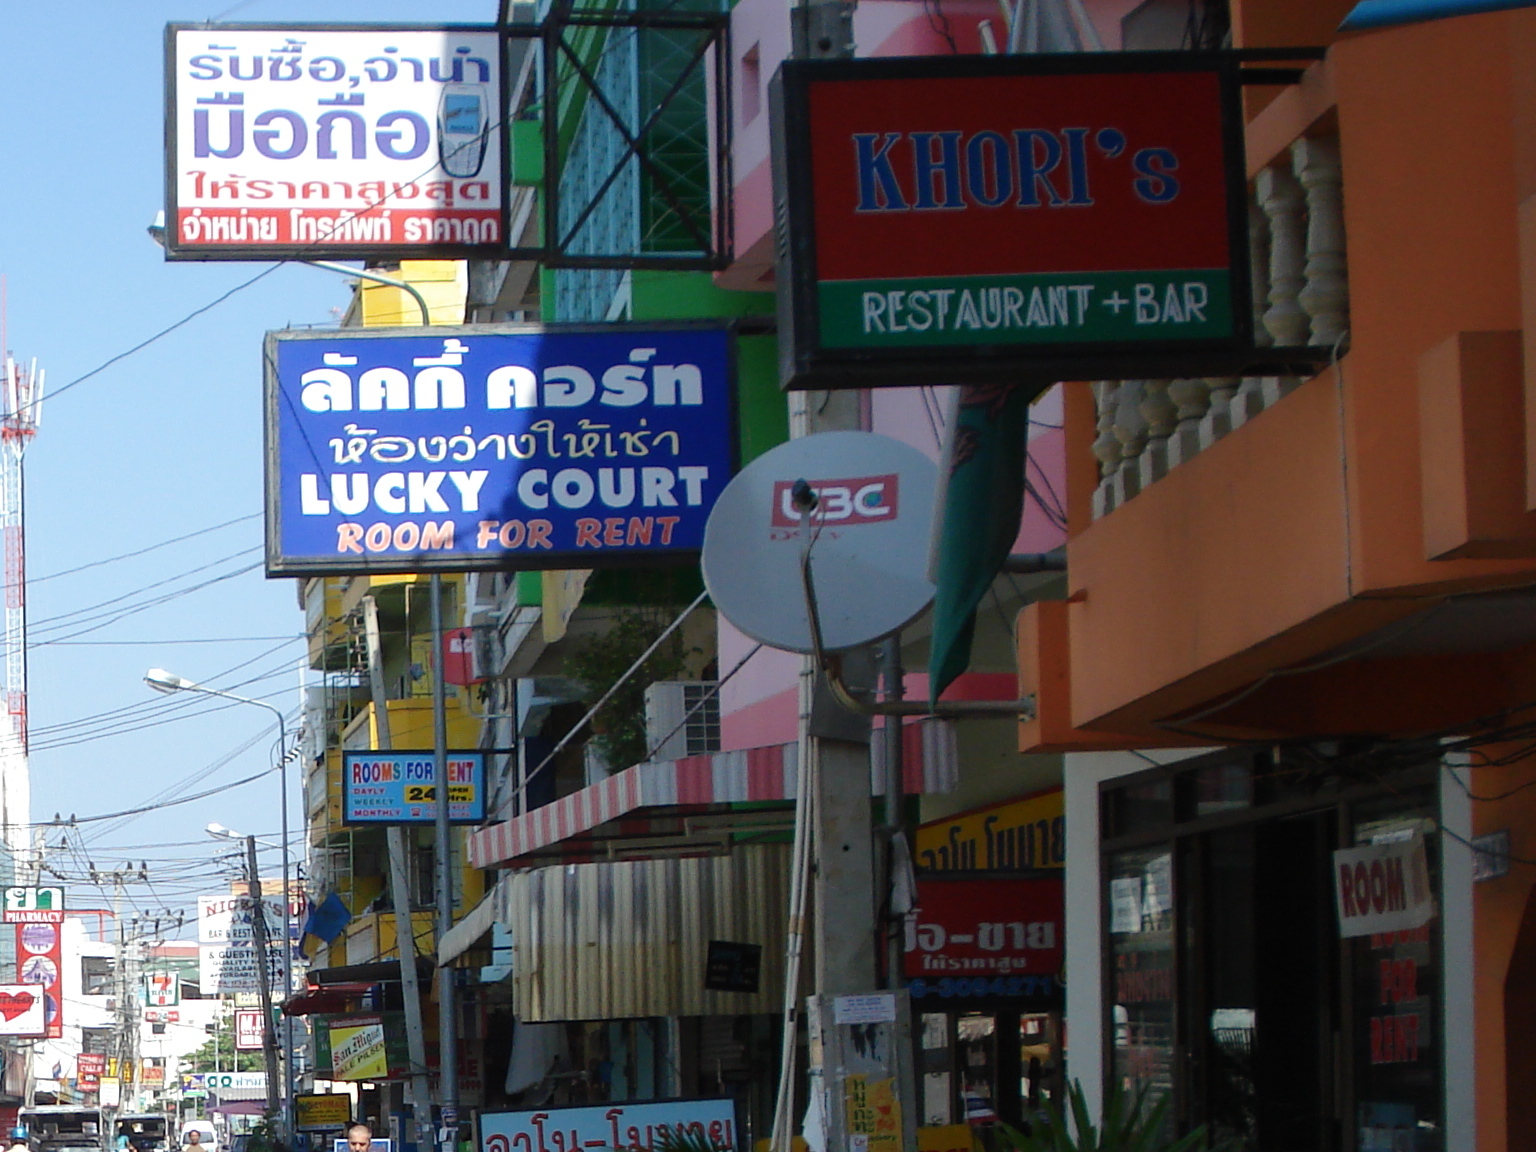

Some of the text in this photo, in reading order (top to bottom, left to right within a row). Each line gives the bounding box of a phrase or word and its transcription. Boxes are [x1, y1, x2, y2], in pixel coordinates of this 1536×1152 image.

[192, 91, 431, 161] มือถือ
[186, 170, 490, 208] ให้ราคาสูงสุด
[852, 126, 1181, 214] KHORI's
[290, 208, 392, 242] โทรศัพท์
[404, 215, 498, 245] ราคาถูก
[862, 284, 1096, 335] RESTAURANT
[486, 347, 703, 409] คอร์ท
[329, 418, 680, 464] ห้องว่างให้เช่า
[299, 465, 709, 516] LUCKY COURT
[336, 515, 680, 554] ROOM FOR RENT
[352, 760, 475, 783] ROOMS FOR ENT
[353, 787, 385, 795] DAYLY
[353, 798, 395, 806] WEEKLY
[409, 787, 436, 801] 24
[353, 809, 402, 817] MONTHLY
[5, 887, 63, 911] ยา
[1340, 856, 1407, 918] ROOM
[5, 911, 62, 923] PHARMACY
[1379, 958, 1418, 1005] FOR
